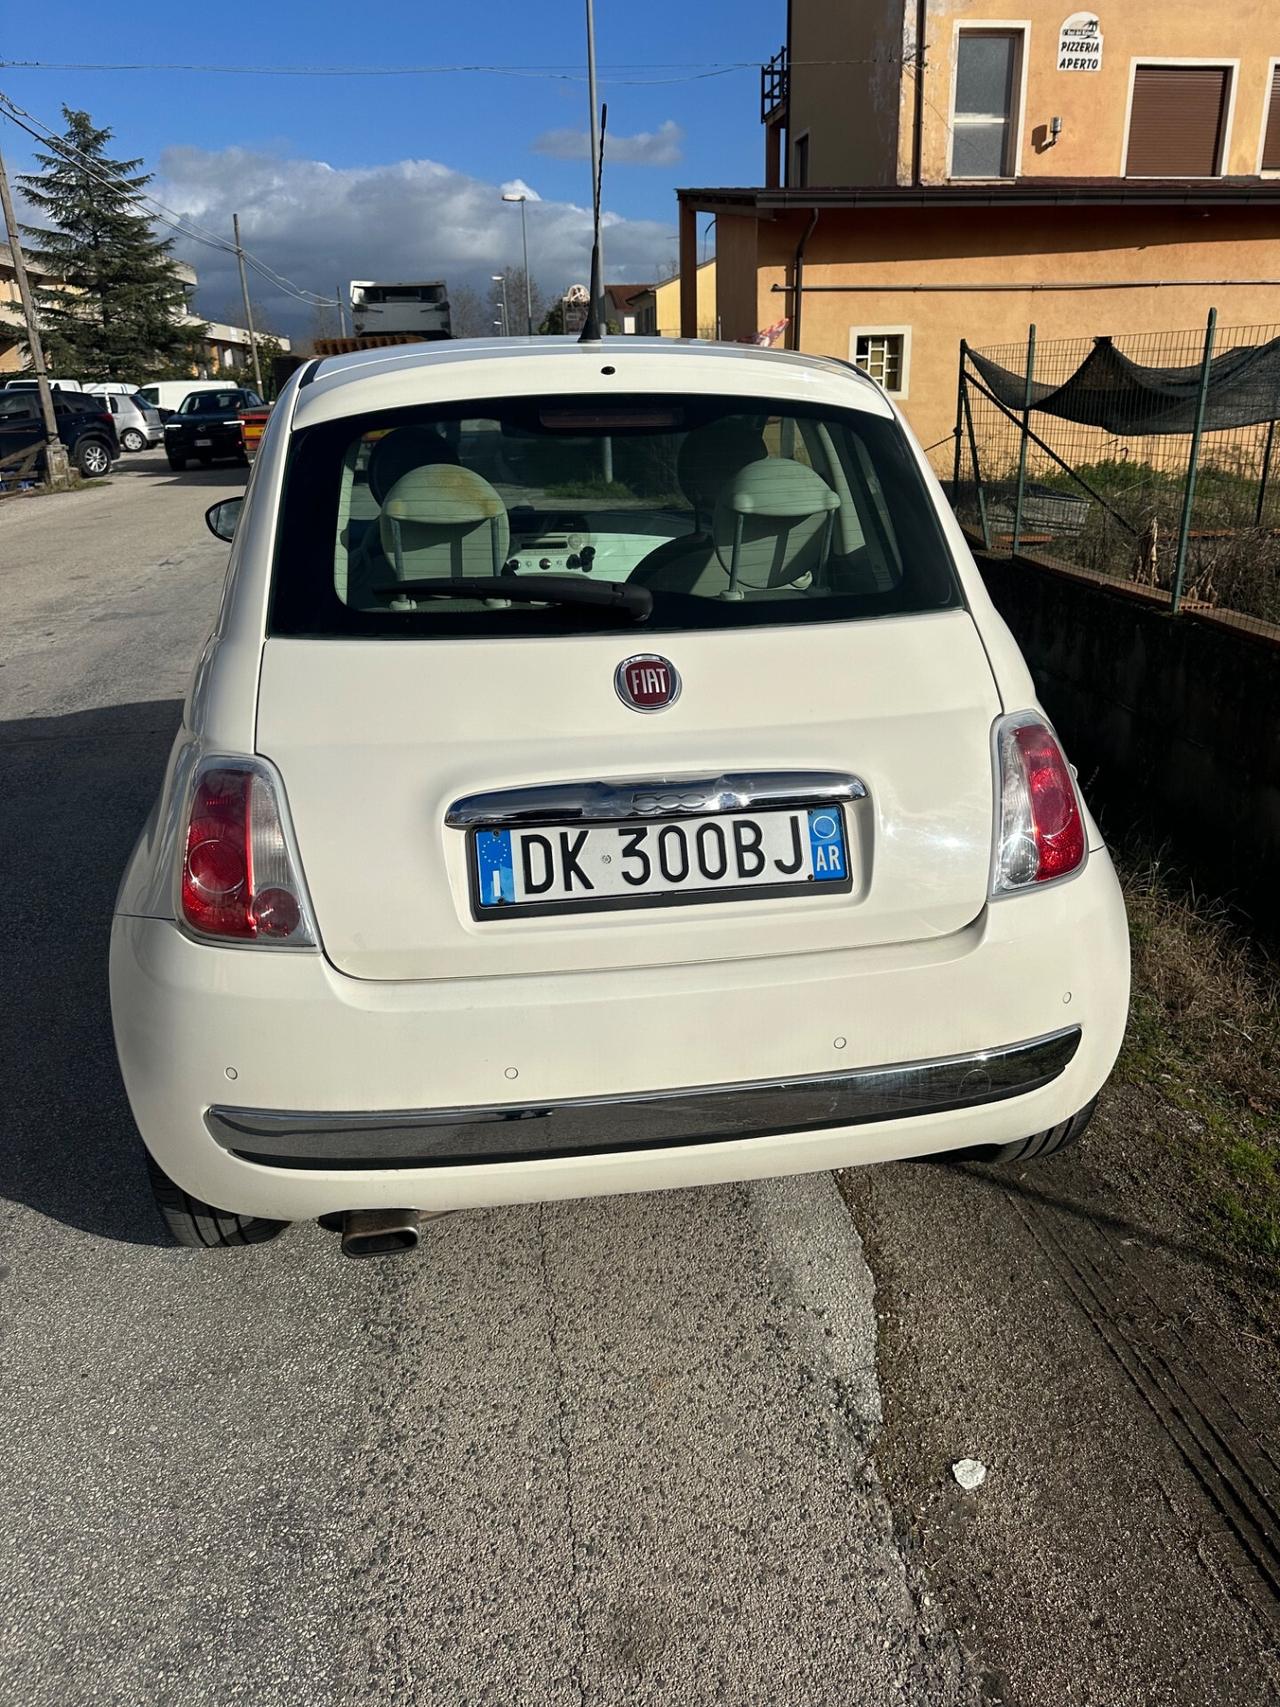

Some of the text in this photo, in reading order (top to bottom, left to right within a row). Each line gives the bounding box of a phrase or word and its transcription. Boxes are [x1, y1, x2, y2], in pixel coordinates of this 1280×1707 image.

[1061, 41, 1100, 53] PIZZERIA
[1059, 58, 1099, 70] APERTO
[631, 668, 666, 695] FIAT
[520, 830, 595, 895] DK
[618, 815, 803, 886] 300BJ
[816, 845, 841, 872] AR
